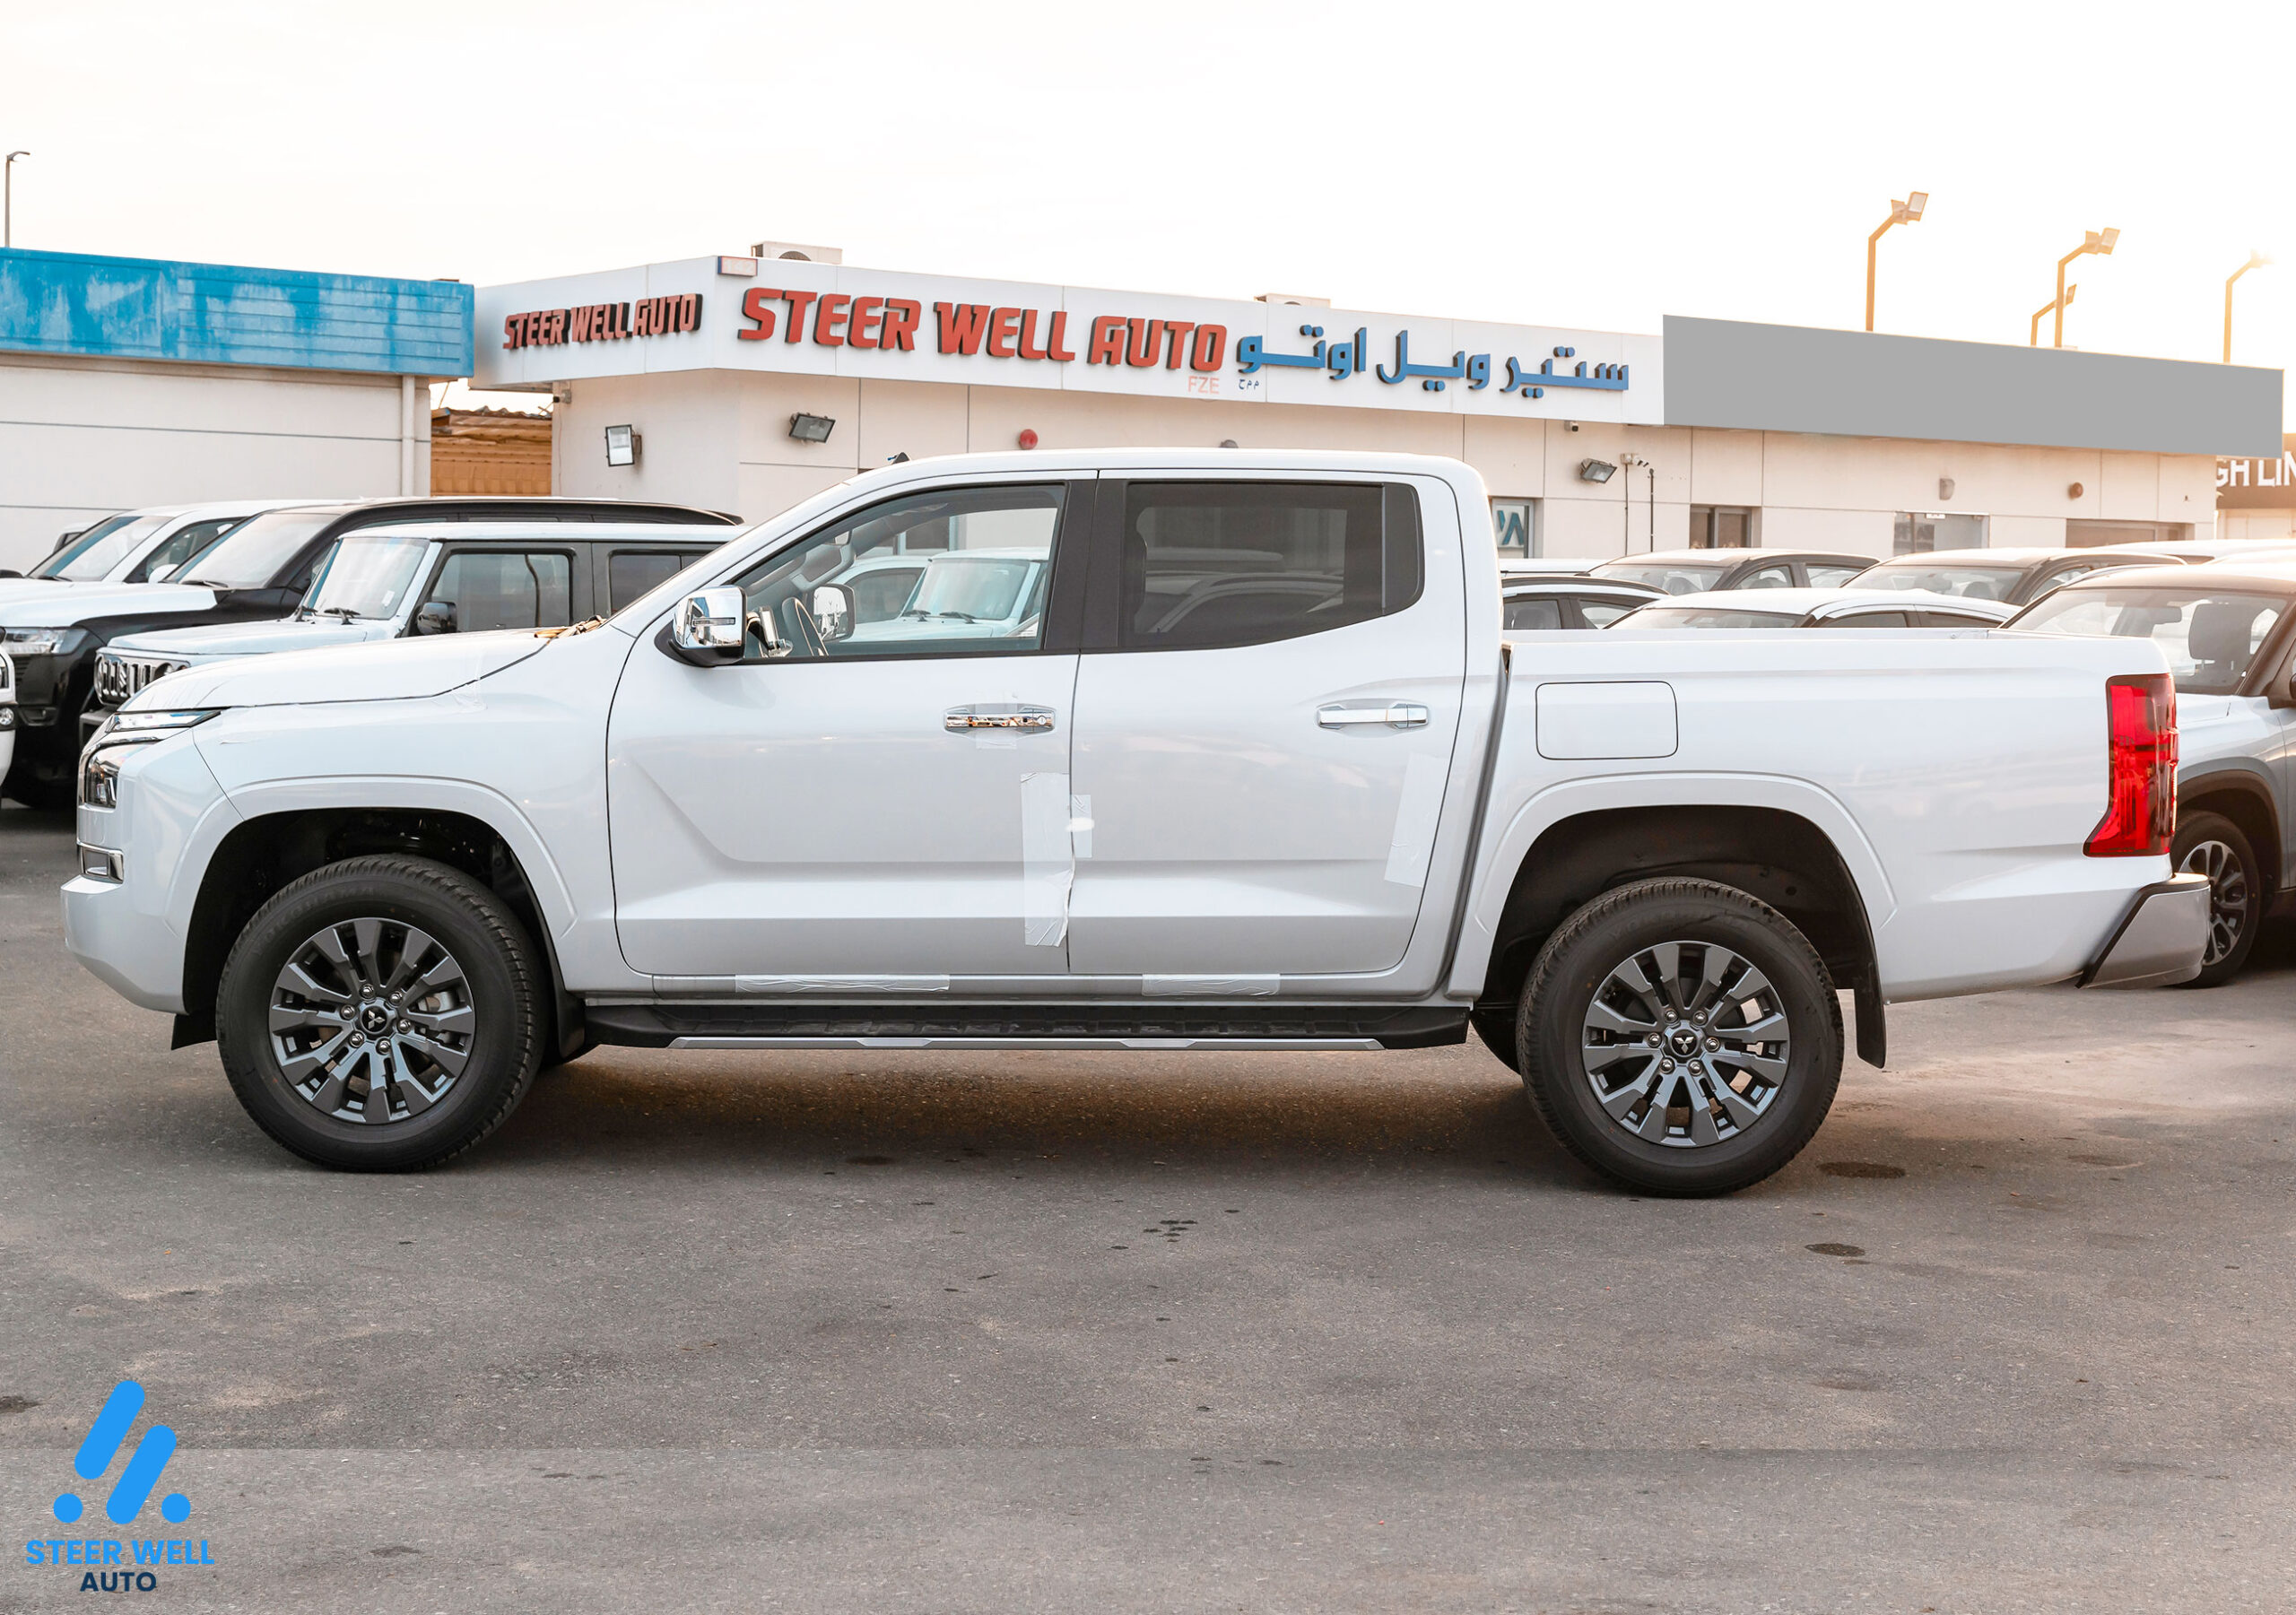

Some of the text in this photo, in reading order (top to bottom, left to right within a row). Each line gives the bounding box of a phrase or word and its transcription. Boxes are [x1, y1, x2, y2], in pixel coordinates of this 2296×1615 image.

[503, 293, 703, 350] STEER WELL AUTO
[737, 287, 1227, 371] STEER WELL AUTO
[1187, 376, 1220, 395] FZE
[1236, 325, 1629, 399] ستير ويل اوتو
